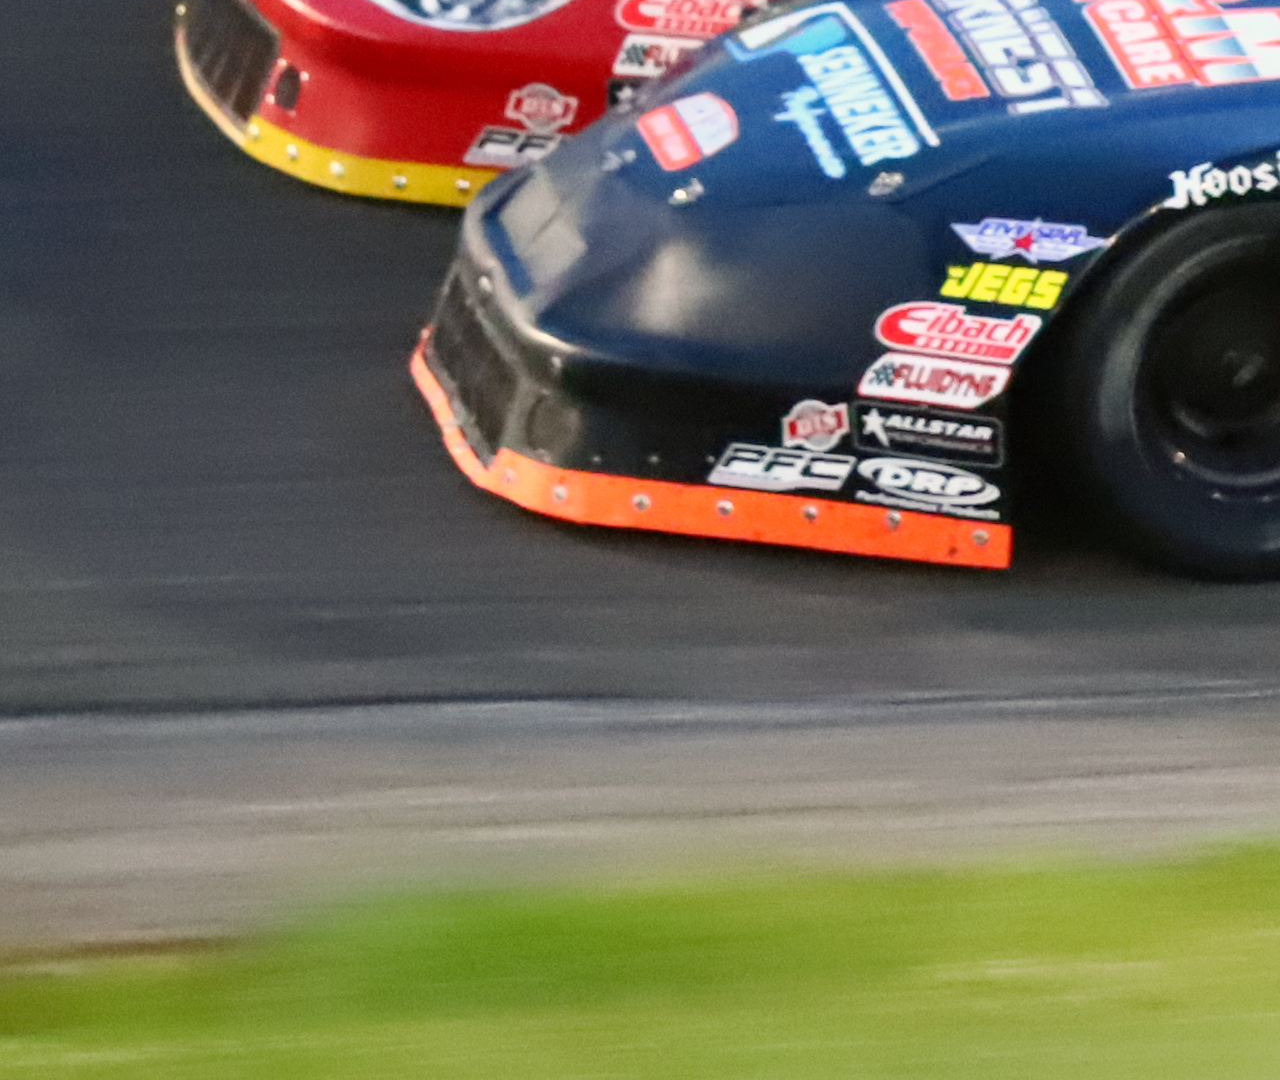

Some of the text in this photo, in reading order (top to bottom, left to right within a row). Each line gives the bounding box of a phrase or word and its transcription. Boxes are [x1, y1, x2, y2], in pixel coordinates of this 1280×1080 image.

[939, 261, 1069, 311] JEGS
[879, 305, 1032, 346] Eibach
[886, 414, 994, 441] ALLSTAR
[722, 447, 848, 481] PFC
[876, 465, 985, 497] DRP
